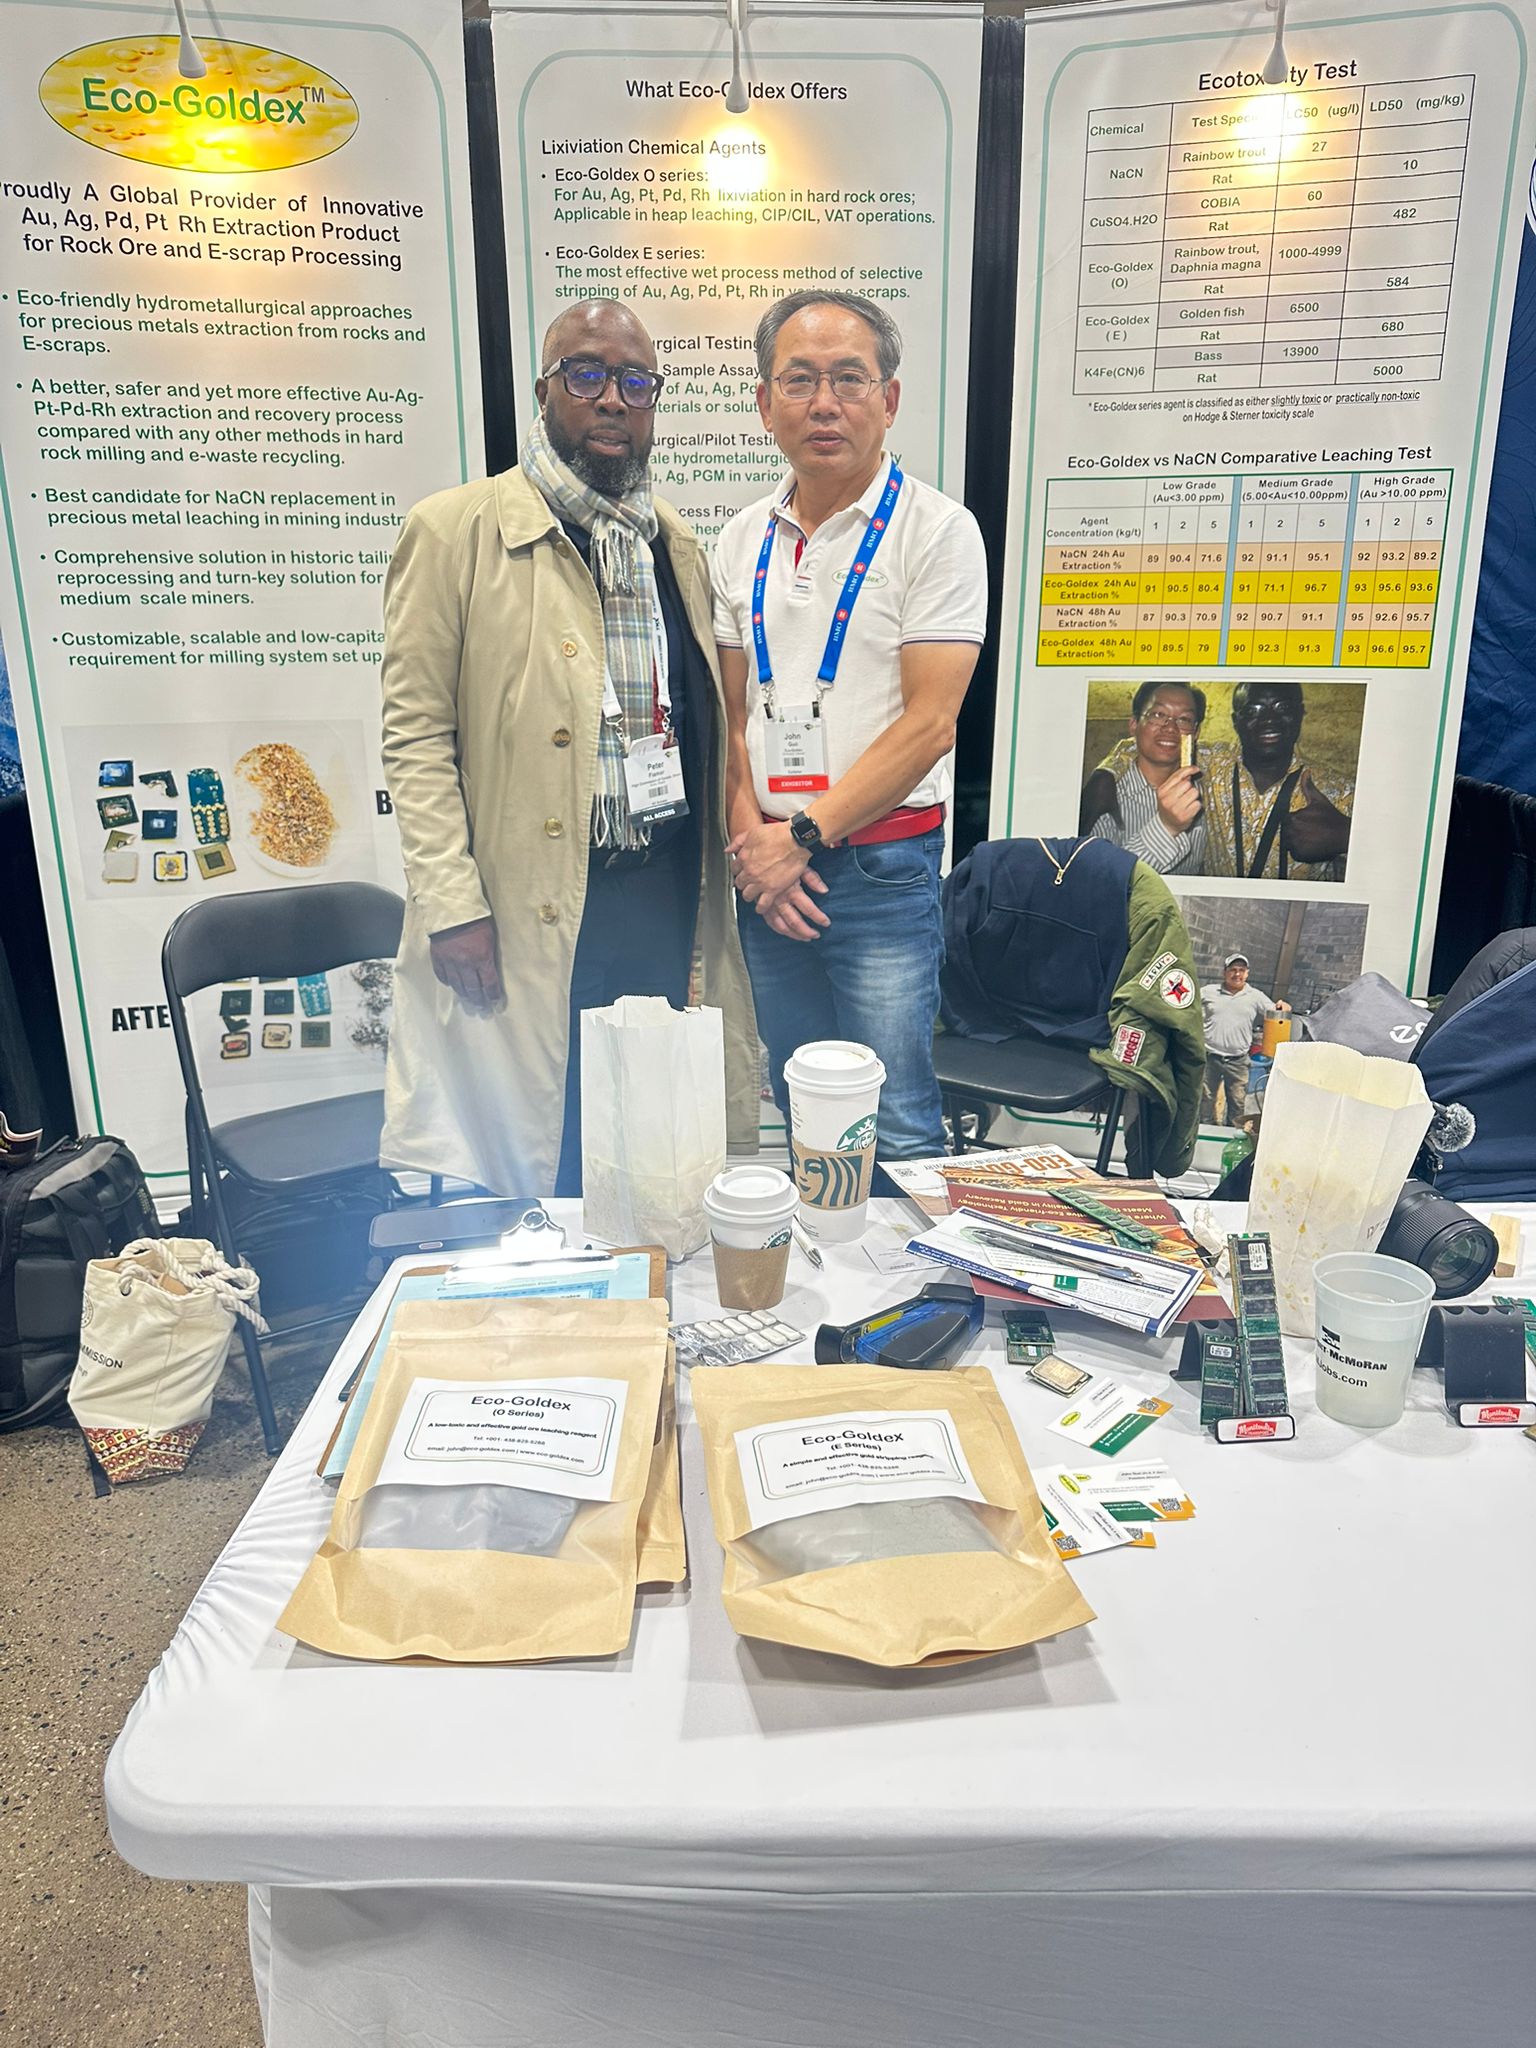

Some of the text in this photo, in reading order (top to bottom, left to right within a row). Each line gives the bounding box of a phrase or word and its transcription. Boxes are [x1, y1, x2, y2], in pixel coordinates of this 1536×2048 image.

[1314, 60, 1357, 80] Test
[626, 80, 847, 100] What Eco-ldex Offers
[82, 77, 326, 125] Eco-Goldex TM
[1370, 93, 1465, 112] LD50 (mg/kg)
[1090, 123, 1144, 136] Chemical
[542, 138, 766, 158] Lixiviation Chemical Agents
[555, 167, 708, 182] Eco-Goldex O series:
[1110, 168, 1143, 179] NaCN
[0, 181, 423, 218] roudly A Global Provider of Innovative
[1201, 190, 1322, 209] COBIA 60
[554, 207, 935, 225] Applicable in heap leaching, CIP/CIL, VAT operations.
[1090, 214, 1158, 228] CuSO4.H2O
[1393, 208, 1416, 219] 482
[22, 207, 400, 242] Au, Ag, Pd, Pt Rh Extraction Product
[23, 233, 401, 272] for Rock Ore and E-scrap Processing
[556, 245, 705, 260] Eco-Goldex E series:
[1173, 243, 1342, 259] Rainbow trout, 1000-4999
[555, 265, 923, 281] The most effective wet process method of selective
[1089, 262, 1153, 273] Eco-Goldex
[1170, 260, 1261, 275] Daphnia magna
[1111, 278, 1128, 289] (O)
[17, 289, 412, 320] Eco-friendly hydrometallurgical approaches
[1179, 302, 1319, 319] Golden fish 6500
[23, 335, 110, 356] E-scraps.
[1194, 346, 1319, 361] Bass 13900
[663, 363, 715, 379] Sample
[1084, 366, 1145, 379] K4Fe(CN)6
[1197, 365, 1403, 383] Rat 5000
[1181, 408, 1314, 424] on Hodge & Sterner toxicity scale
[1068, 446, 1432, 468] Eco-Goldex vs NaCN Comparative Leaching Test
[693, 469, 725, 482] PGM
[1162, 475, 1436, 491] Low Grade Medium Grade High Grade
[45, 488, 395, 508] Best candidate for NaCN replacement in
[885, 488, 895, 507] BMO
[866, 530, 879, 548] BMO
[1059, 549, 1126, 559] NaCN 24h Au
[1146, 551, 1438, 564] 89 90.4 71.6 92 91.1 95.1 92 93.2 89.2
[848, 574, 859, 593] BMO
[832, 621, 843, 643] BMO
[643, 808, 676, 823] ALL ACCESS
[1147, 959, 1168, 982] ARMY
[112, 1005, 170, 1032] AFTE
[1122, 1030, 1142, 1066] UGGED
[471, 1395, 572, 1411] Eco-Goldex
[491, 1408, 545, 1420] (O Series)
[427, 1421, 435, 1429] A
[480, 1422, 511, 1430] effective
[540, 1426, 570, 1437] leaching
[569, 1430, 598, 1440] reagent
[802, 1430, 905, 1444] Eco-Goldex
[830, 1441, 883, 1452] (E Series)
